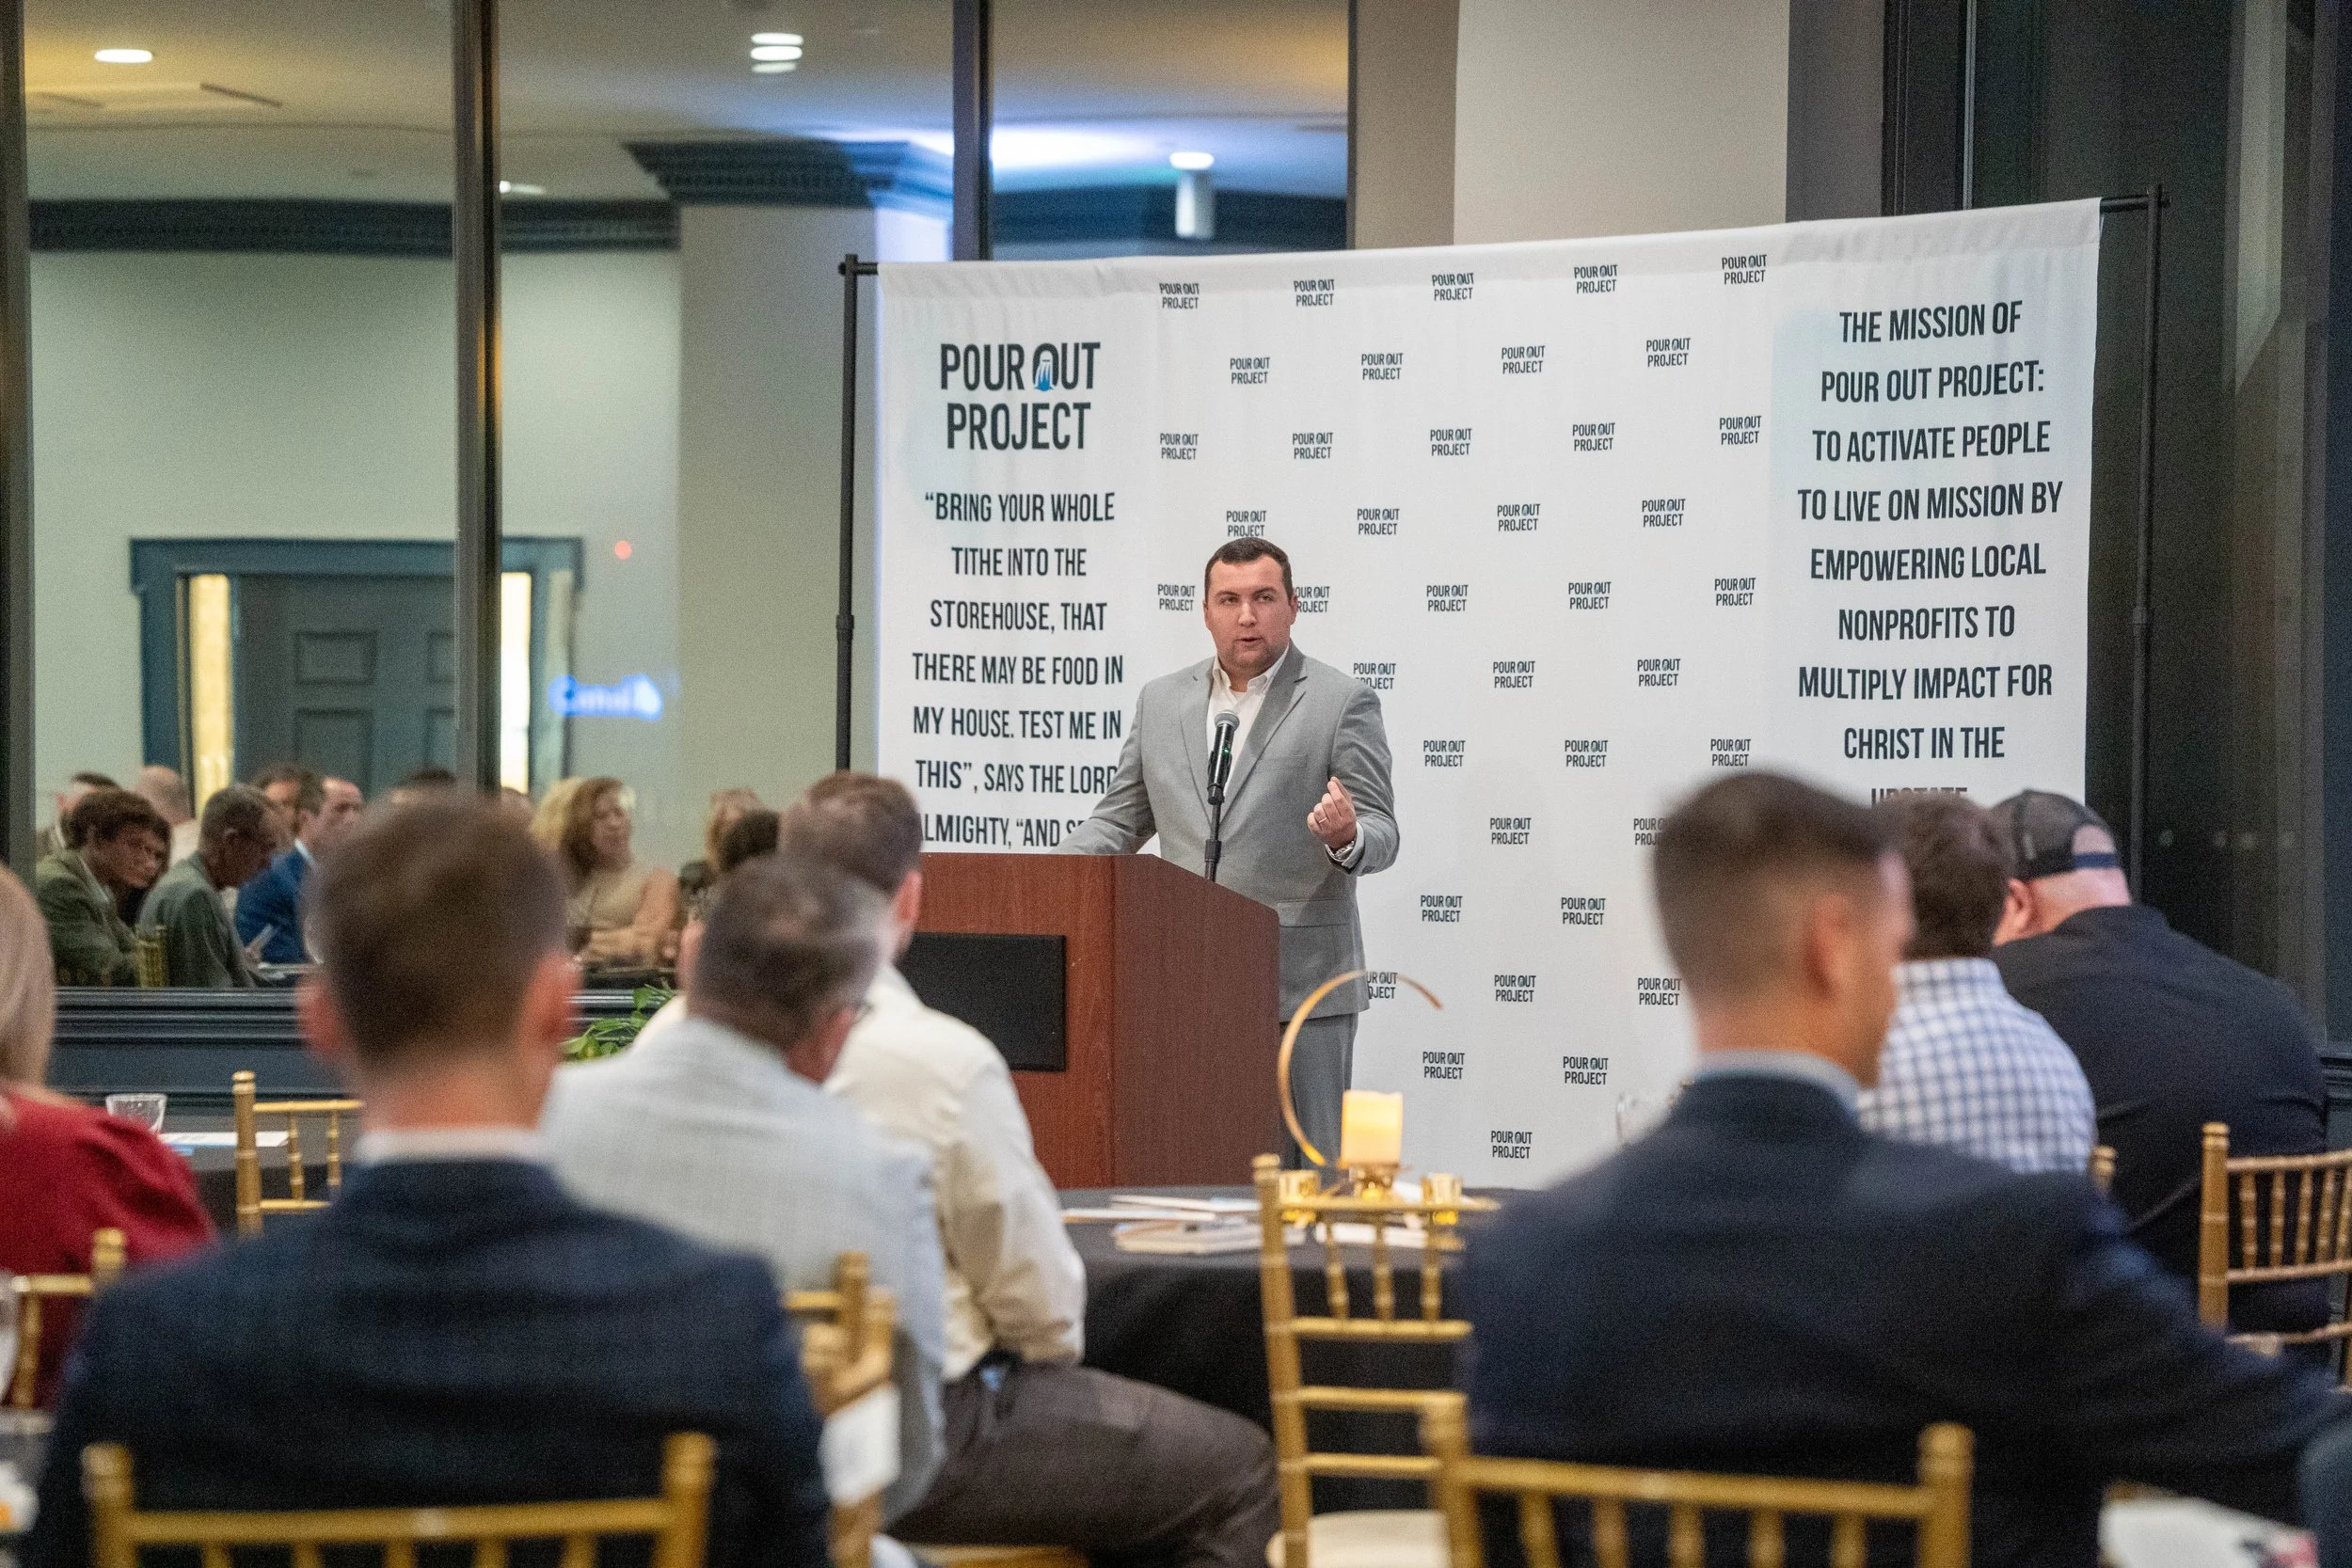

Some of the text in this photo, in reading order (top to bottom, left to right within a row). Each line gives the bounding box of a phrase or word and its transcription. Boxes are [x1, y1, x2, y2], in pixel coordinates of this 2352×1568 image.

[1722, 254, 1767, 269] POUR OUT
[1574, 264, 1617, 278] POUR OUT
[1724, 269, 1765, 284] PROJECT
[1294, 278, 1334, 292] POUR OUT
[1432, 273, 1474, 286] POUR OUT
[1577, 279, 1616, 293] PROJECT
[1159, 282, 1200, 294] POUR OUT
[1434, 287, 1472, 301] PROJECT
[1162, 296, 1199, 309] PROJECT
[1296, 293, 1333, 307] PROJECT
[1839, 300, 2023, 342] THE MISSION OF
[1502, 345, 1545, 359] POUR OUT
[1646, 338, 1691, 352] POUR OUT
[941, 341, 1101, 391] POUR OUT
[1230, 356, 1270, 370] POUR OUT
[1361, 353, 1403, 366] POUR OUT
[1647, 353, 1688, 367] PROJECT
[1362, 368, 1401, 380] PROJECT
[1502, 360, 1543, 374] PROJECT
[1232, 372, 1268, 385] PROJECT
[1821, 360, 2044, 403] POUR OUT PROJECT:
[947, 402, 1091, 451] PROJECT
[1572, 422, 1615, 436] POUR OUT
[1720, 416, 1761, 430] POUR OUT
[1160, 433, 1199, 446] POUR OUT
[1293, 432, 1333, 445] POUR OUT
[1430, 428, 1472, 441] POUR OUT
[1721, 431, 1759, 445] PROJECT
[1812, 420, 2050, 462] TO ACTIVATE PEOPLE
[1431, 443, 1470, 456] PROJECT
[1574, 437, 1613, 451] PROJECT
[1161, 447, 1197, 460] PROJECT
[1294, 447, 1331, 459] PROJECT
[925, 492, 1115, 522] “BRING YOUR WHOLE
[1642, 499, 1686, 513] POUR OUT
[1798, 481, 2063, 522] TO LIVE ON MISSION BY
[1357, 508, 1400, 520] POUR OUT
[1497, 503, 1540, 517] POUR OUT
[1499, 518, 1538, 531] PROJECT
[1644, 514, 1683, 527] PROJECT
[1359, 523, 1397, 535] PROJECT
[951, 546, 1087, 577] TITHE INTO THE
[1811, 543, 2046, 581] EMPOWERING LOCAL
[1157, 584, 1195, 597] POUR OUT
[1426, 584, 1469, 597] POUR OUT
[1568, 581, 1612, 594] POUR OUT
[1714, 578, 1756, 591] POUR OUT
[1159, 598, 1193, 611] PROJECT
[1428, 599, 1467, 611] PROJECT
[1569, 596, 1609, 610] PROJECT
[1716, 593, 1754, 606] PROJECT
[930, 599, 1107, 634] STOREHOUSE, THAT
[1839, 605, 2014, 641] NONPROFITS TO
[913, 652, 1123, 685] THERE MAY BE FOOD IN
[1493, 660, 1535, 673] POUR OUT
[1637, 658, 1681, 672] POUR OUT
[1494, 675, 1534, 689] PROJECT
[1639, 673, 1678, 687] PROJECT
[1799, 664, 2052, 700] MULTIPLY IMPACT FOR
[914, 706, 1121, 739] MY HOUSE. TEST ME IN
[1423, 740, 1466, 752] POUR OUT
[1565, 739, 1608, 752] POUR OUT
[1710, 738, 1751, 752] POUR OUT
[1844, 726, 2005, 759] CHRIST IN THE
[1424, 754, 1463, 767] PROJECT
[1566, 754, 1606, 768] PROJECT
[1712, 753, 1749, 766] PROJECT
[984, 763, 1025, 792] SAYS
[1030, 765, 1064, 793] THE
[1490, 817, 1532, 830] POUR OUT
[923, 814, 1011, 849] LMIGHTY,
[1491, 832, 1530, 845] PROJECT
[1421, 895, 1463, 908] POUR OUT
[1561, 897, 1606, 911] POUR OUT
[1422, 910, 1460, 923] PROJECT
[1563, 911, 1604, 926] PROJECT
[1494, 974, 1536, 988] POUR OUT
[1496, 990, 1534, 1003] PROJECT
[1422, 1052, 1465, 1065] POUR OUT
[1563, 1056, 1609, 1070] POUR OUT
[1424, 1066, 1463, 1080] PROJECT
[1565, 1071, 1607, 1085] PROJECT
[1491, 1131, 1533, 1144] POUR OUT
[1492, 1145, 1531, 1159] PROJECT
